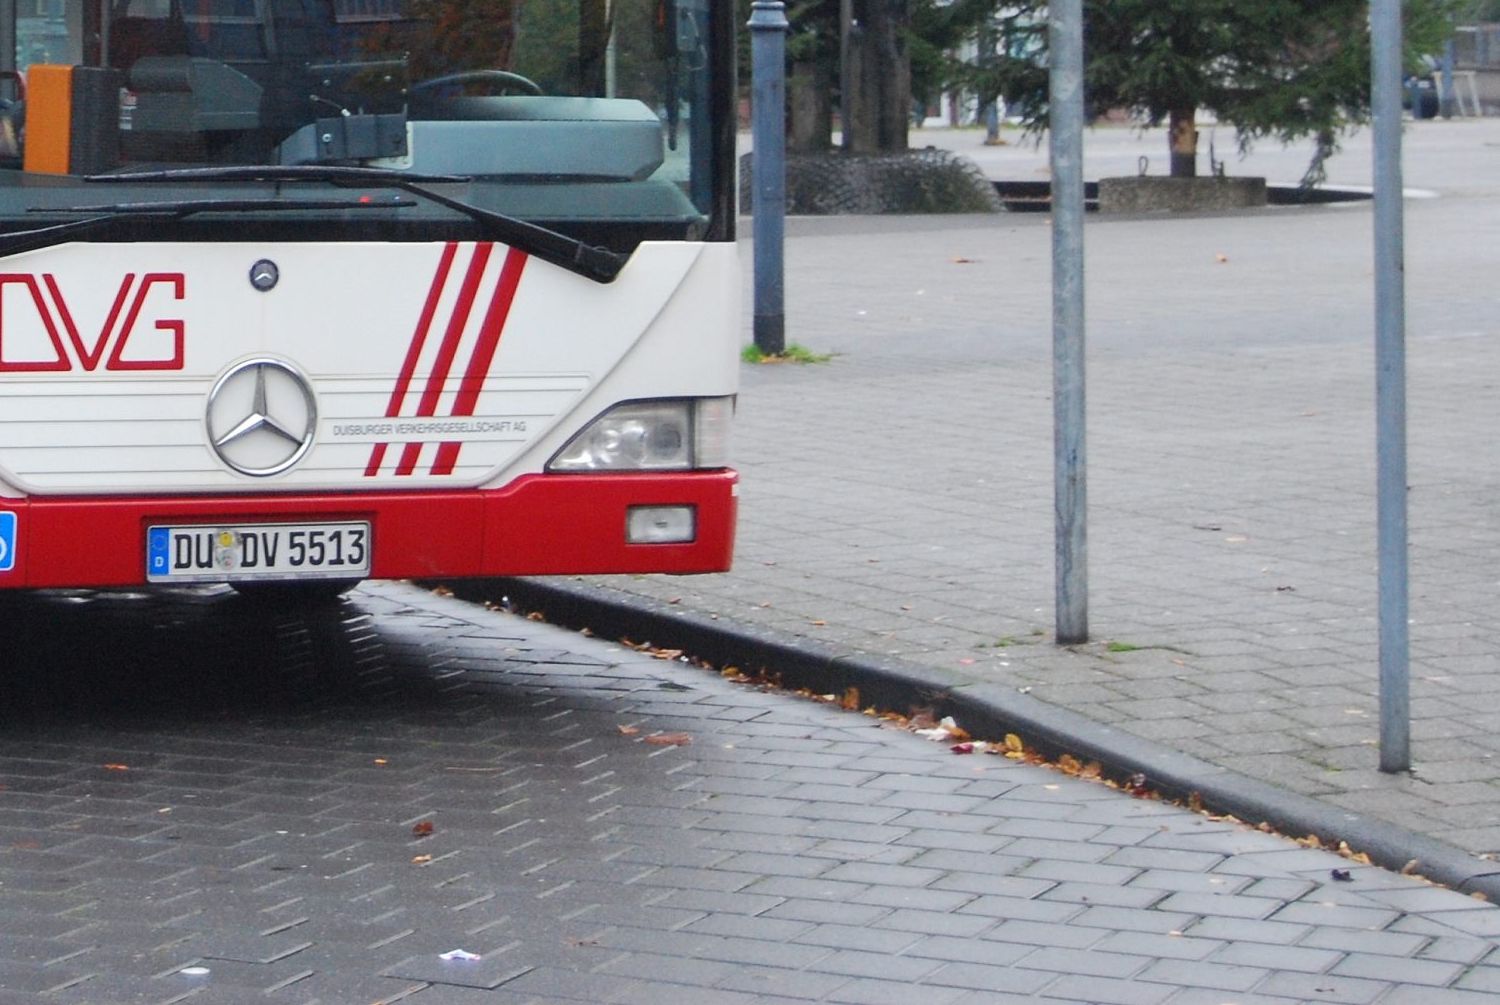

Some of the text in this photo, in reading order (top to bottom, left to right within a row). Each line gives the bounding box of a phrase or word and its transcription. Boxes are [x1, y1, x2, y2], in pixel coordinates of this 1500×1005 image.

[332, 420, 527, 437] DUISBURGER VERKEHRSGESELLSCHAFT AG
[174, 529, 366, 569] DU DV 5513
